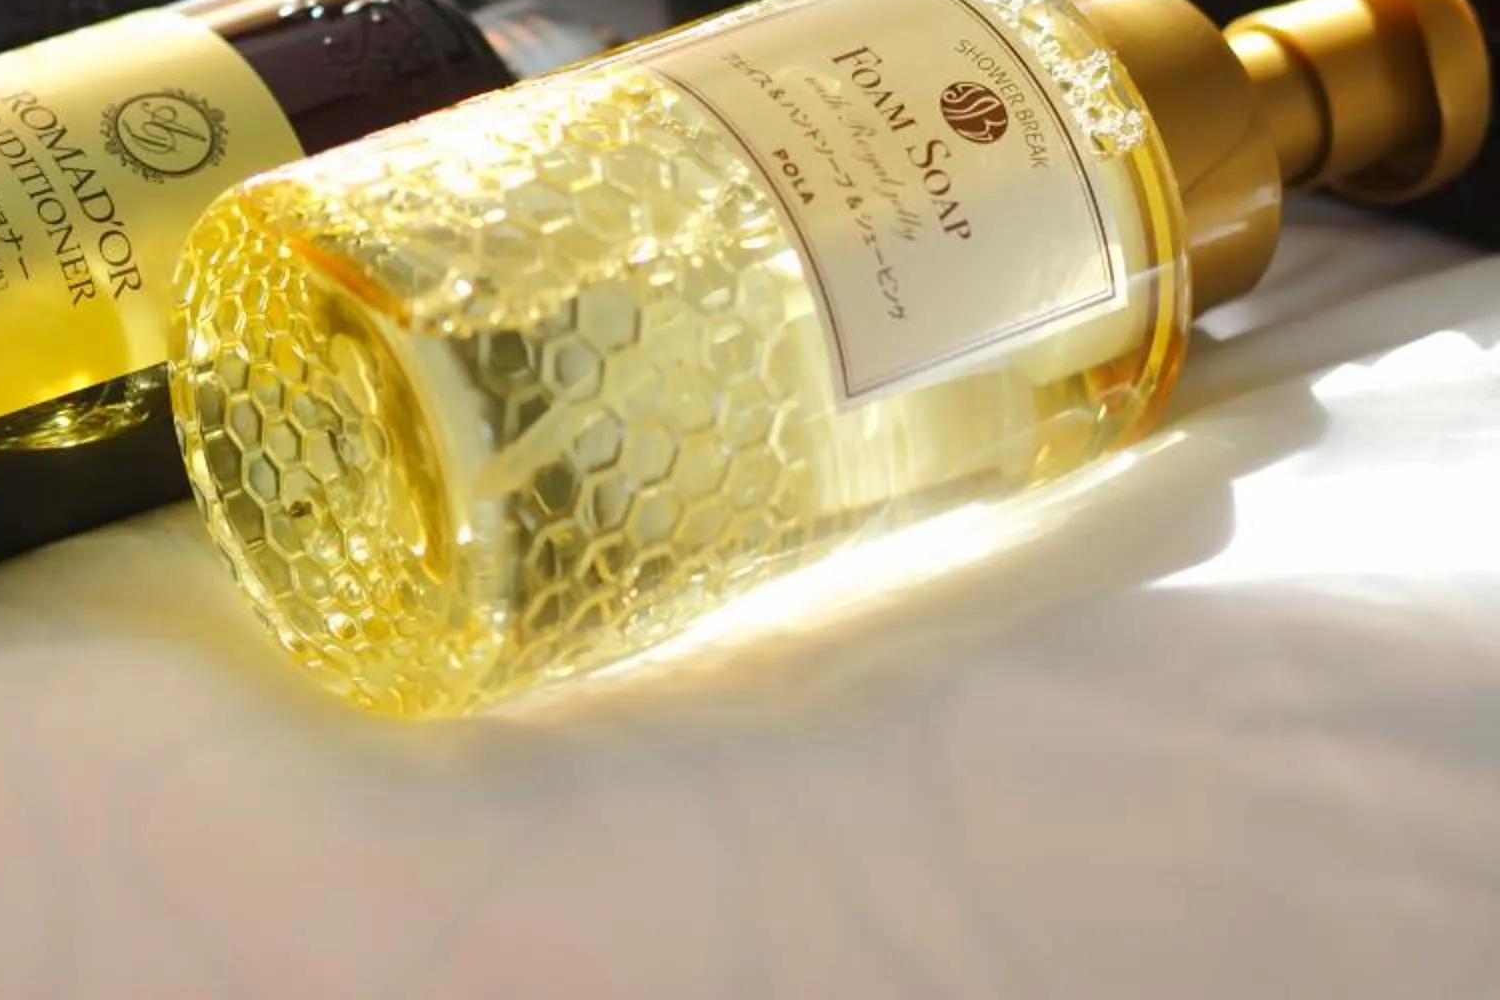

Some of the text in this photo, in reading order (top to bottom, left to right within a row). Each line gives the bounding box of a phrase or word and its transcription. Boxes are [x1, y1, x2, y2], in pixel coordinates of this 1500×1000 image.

[773, 148, 815, 205] POLA
[832, 46, 972, 240] FOAM SOAP
[954, 39, 1024, 106] SHOWER
[1015, 109, 1051, 169] BREAK
[1, 91, 142, 300] ROMAD'OR
